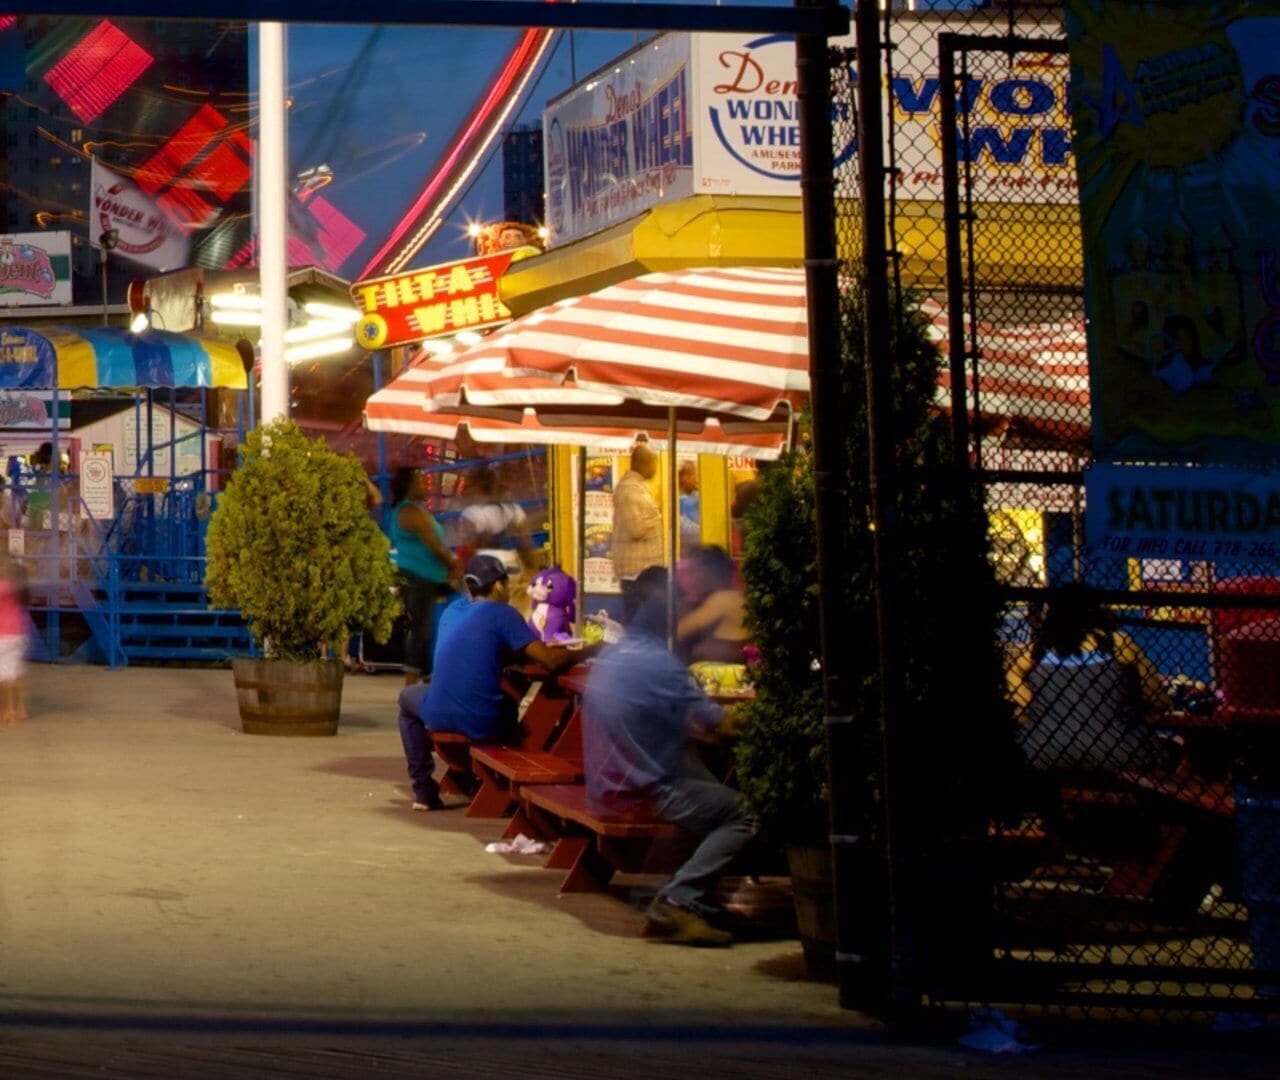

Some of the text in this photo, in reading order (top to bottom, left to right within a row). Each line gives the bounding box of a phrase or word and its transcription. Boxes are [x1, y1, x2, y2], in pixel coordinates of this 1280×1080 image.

[714, 51, 797, 94] Den
[740, 126, 802, 146] WHE
[751, 150, 802, 159] AMUSEM
[1107, 487, 1280, 533] SATURDA
[1136, 537, 1168, 554] INFO
[1174, 538, 1209, 556] CALL
